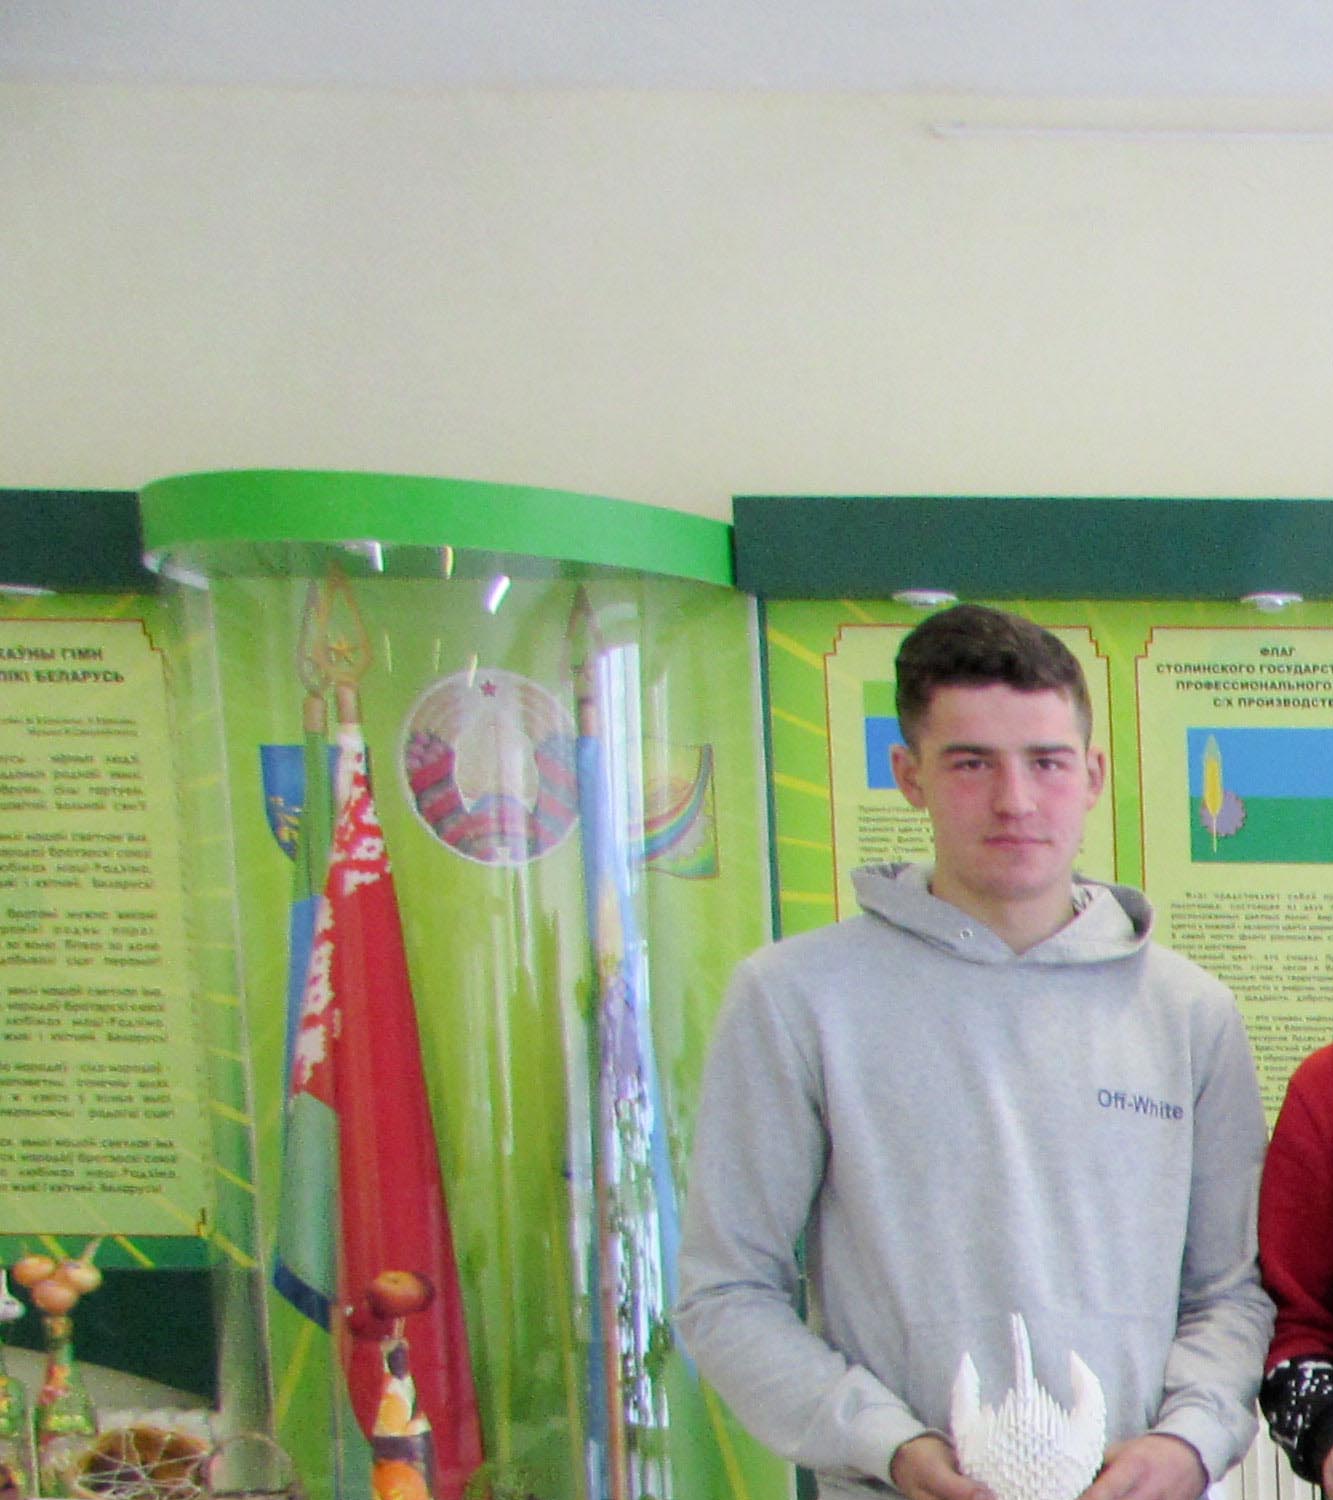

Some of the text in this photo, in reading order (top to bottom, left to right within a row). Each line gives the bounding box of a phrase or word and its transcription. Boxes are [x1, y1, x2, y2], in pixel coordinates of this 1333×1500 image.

[1260, 647, 1296, 657] ФЛАГ
[1156, 663, 1255, 674] СТОЛИНСКОГО
[35, 670, 124, 683] БЕЛАРУСЬ
[1176, 680, 1332, 691] ПРОФЕССИОНАЛЬНОГО
[1098, 1089, 1184, 1120] Off-White
